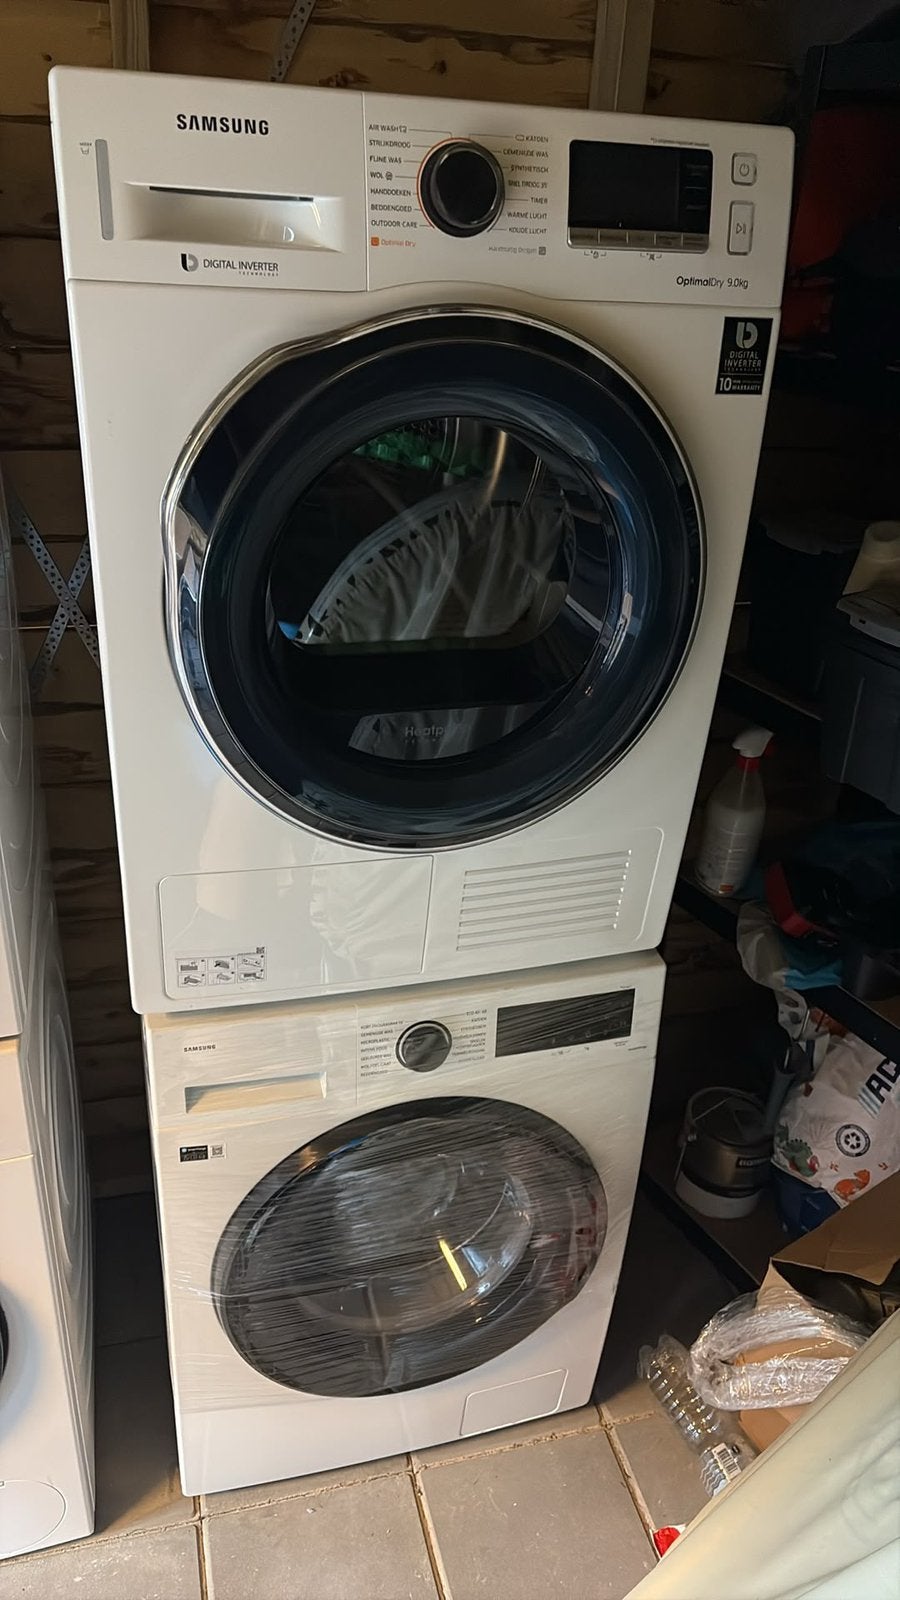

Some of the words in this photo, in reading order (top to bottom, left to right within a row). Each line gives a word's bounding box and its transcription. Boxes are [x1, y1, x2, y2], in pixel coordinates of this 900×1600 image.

[176, 113, 270, 135] SAMSUNG
[388, 156, 402, 164] WAS
[370, 171, 384, 179] WOL
[370, 188, 411, 197] HANDDOEKEN
[530, 196, 548, 204] TIMER
[370, 203, 412, 212] BEDDENGOED
[529, 212, 547, 220] LUCHT
[371, 219, 401, 228] OUTDOOR
[203, 258, 237, 270] DIGITAL
[238, 261, 279, 272] INVERTER
[676, 275, 724, 289] OptimalDry
[727, 277, 749, 290] 9.0kg
[729, 350, 759, 359] DIGITAL
[724, 359, 762, 368] INVERTER
[719, 377, 732, 392] 10
[183, 1044, 216, 1053] SAMSUNG
